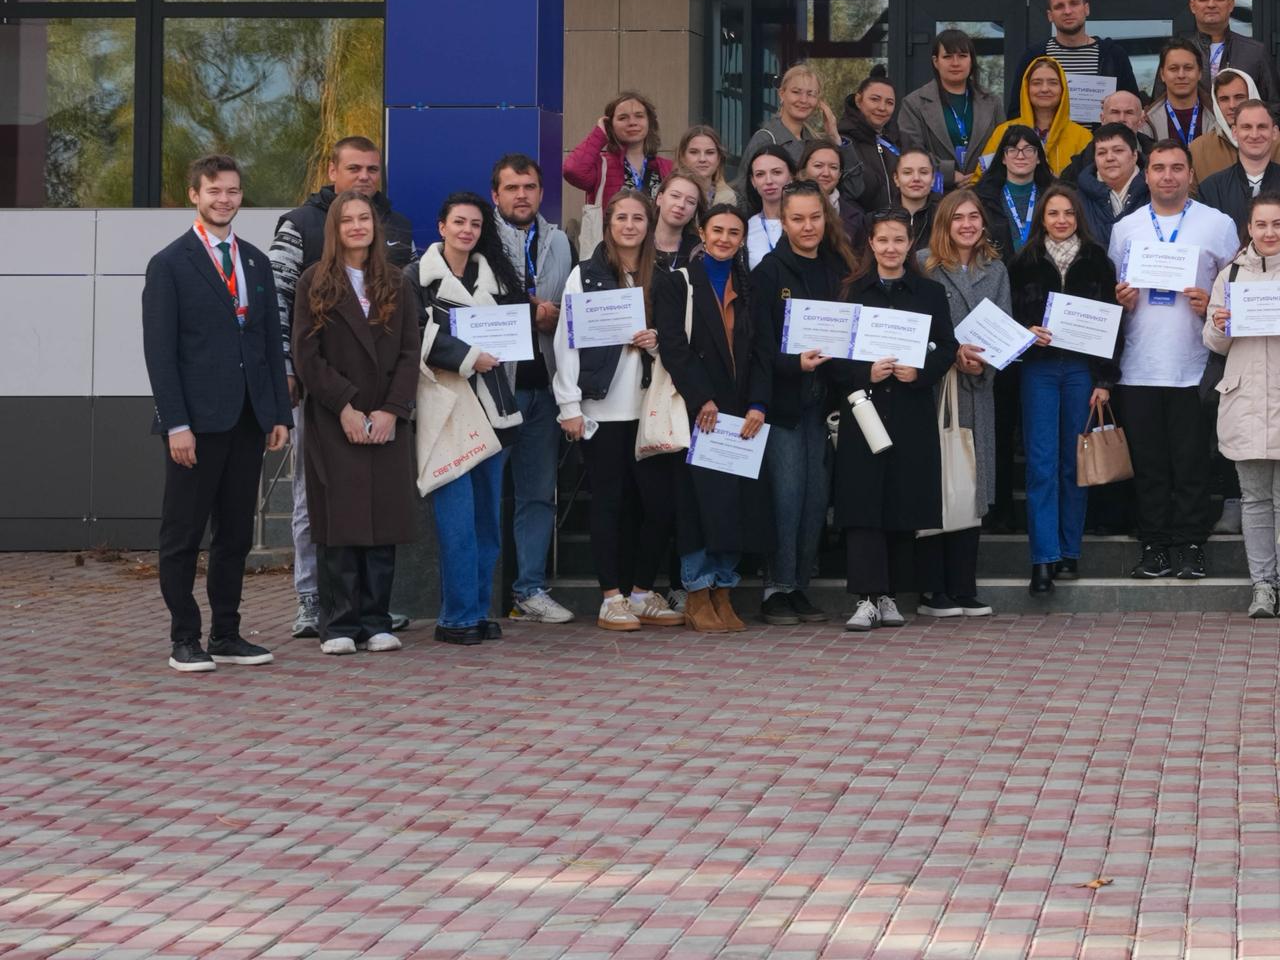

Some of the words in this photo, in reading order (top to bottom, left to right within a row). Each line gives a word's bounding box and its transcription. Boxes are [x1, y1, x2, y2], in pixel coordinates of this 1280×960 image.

[585, 303, 632, 312] СЕРТИФИКАТ
[803, 315, 849, 323] СЕРТИФИКАТ
[433, 463, 452, 478] СВЕТ
[453, 444, 487, 467] ВНУТРИ
